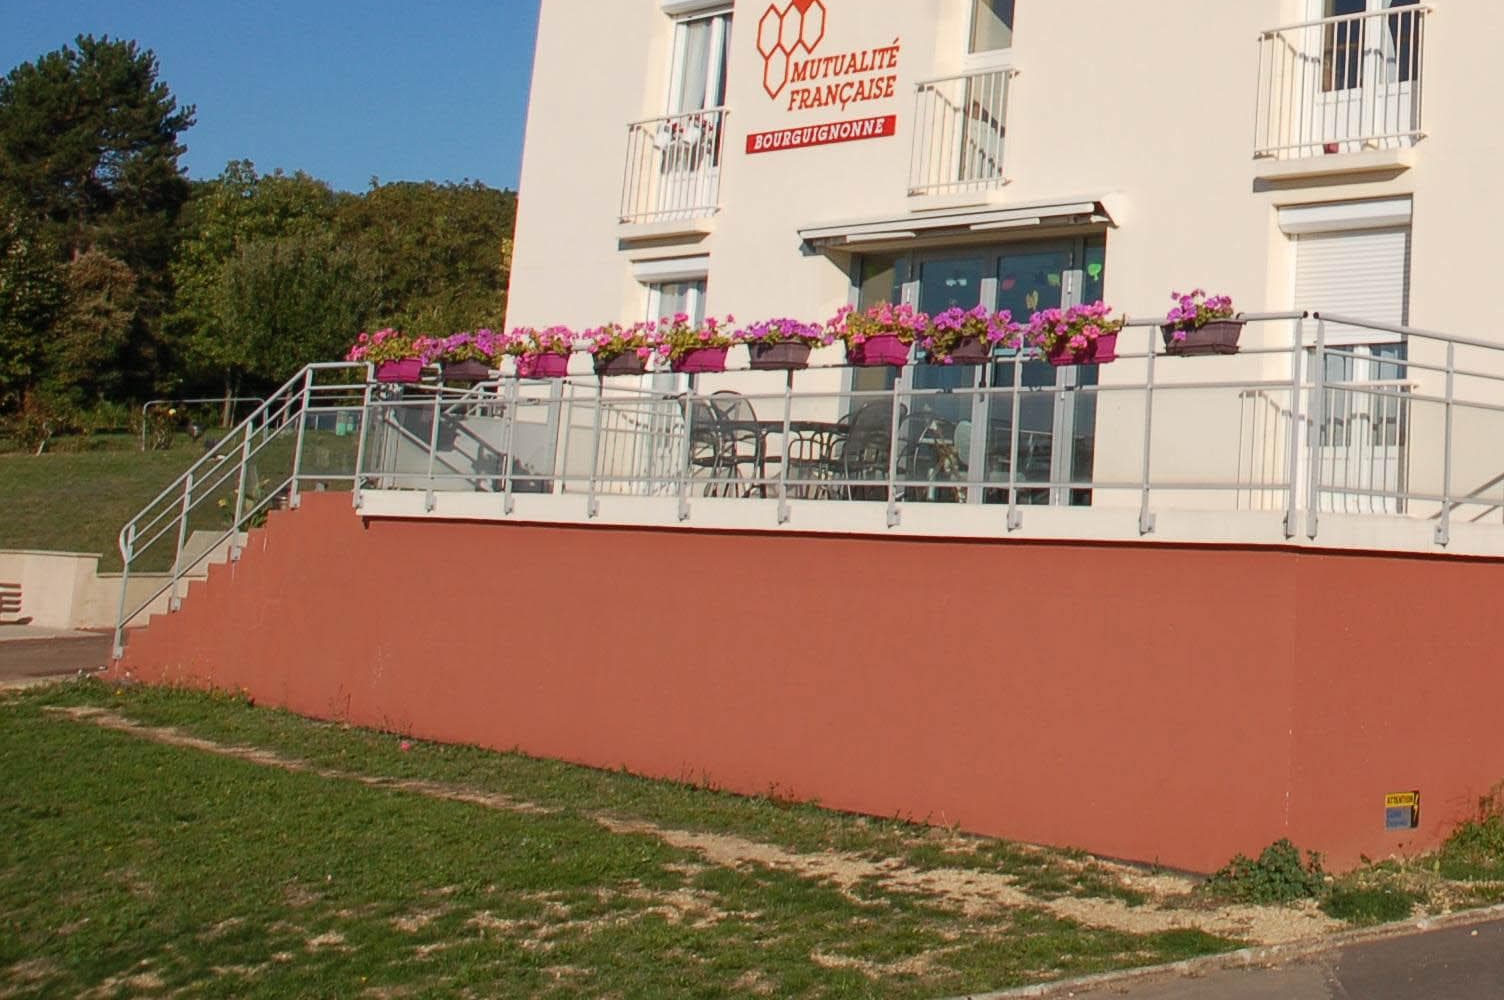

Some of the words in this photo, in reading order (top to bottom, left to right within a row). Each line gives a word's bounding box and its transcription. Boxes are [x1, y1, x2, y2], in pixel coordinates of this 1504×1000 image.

[790, 37, 900, 83] MUTUALITÉ
[787, 75, 897, 111] FRANÇAISE
[754, 118, 885, 150] BOURGUIGNONNE
